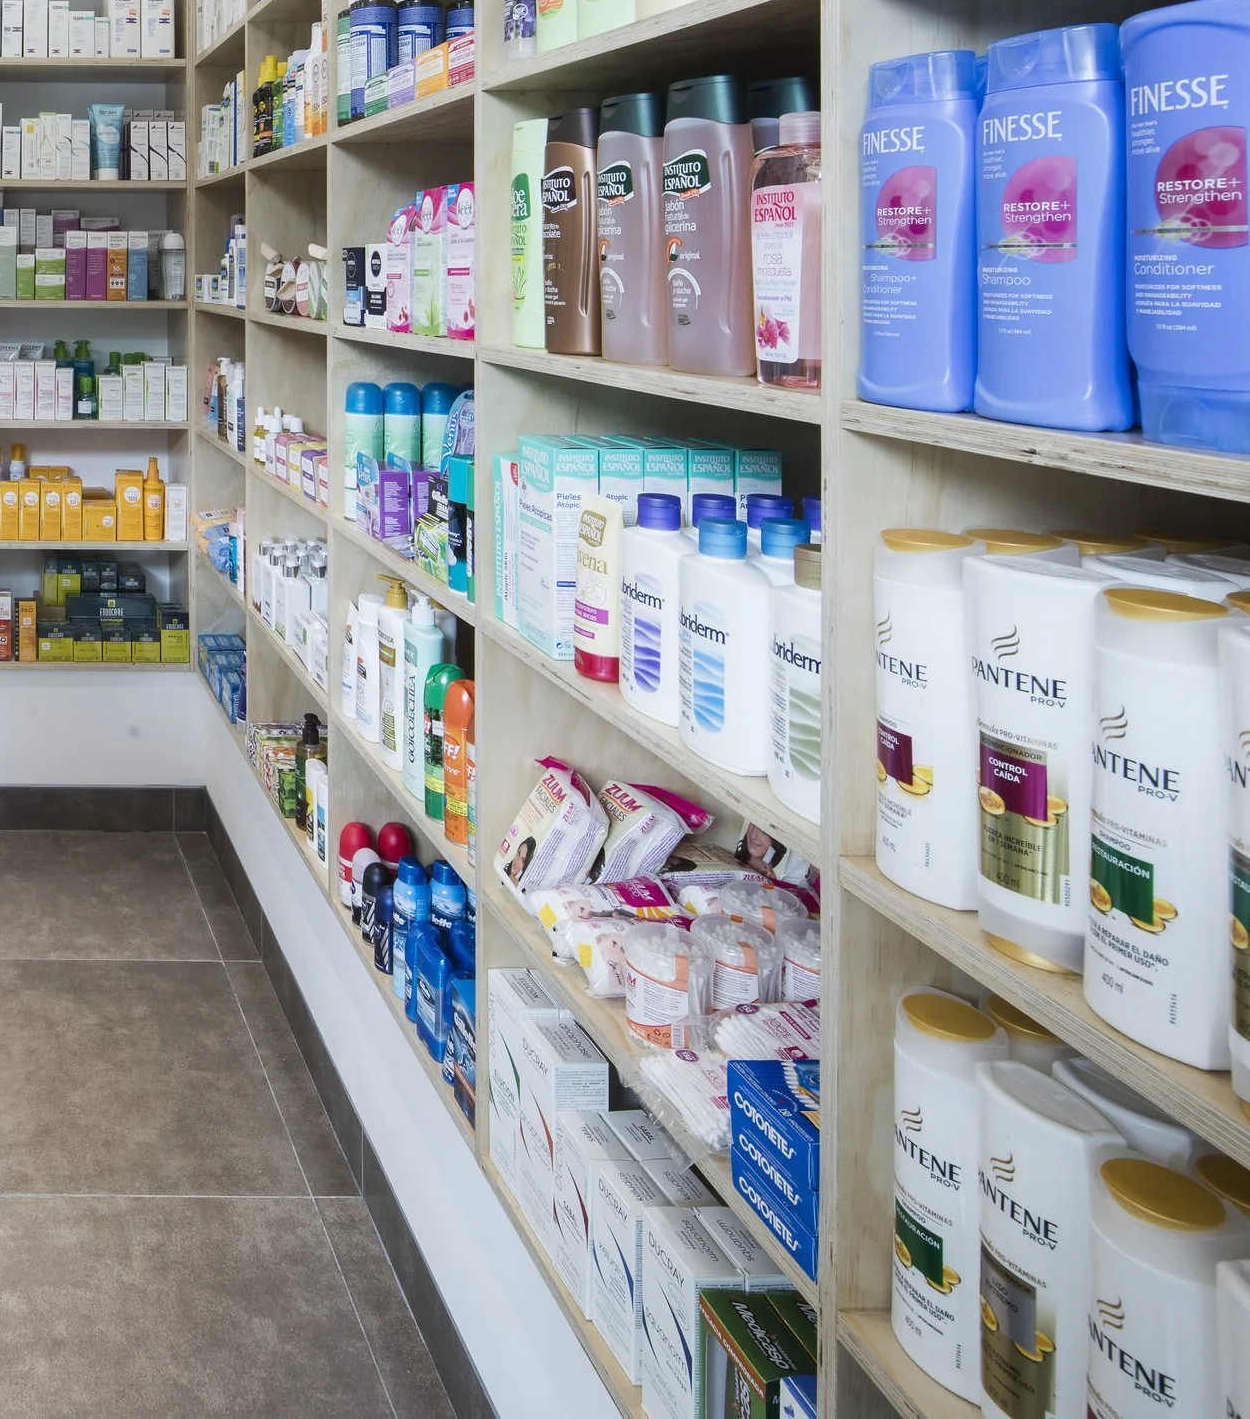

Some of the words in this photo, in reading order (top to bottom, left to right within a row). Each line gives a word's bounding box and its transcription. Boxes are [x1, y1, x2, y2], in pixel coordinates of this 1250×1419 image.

[1131, 74, 1229, 117] FINESSE
[982, 110, 1062, 146] FINESSE
[862, 126, 925, 157] FINESSE
[664, 161, 701, 177] INSTITUTO
[664, 174, 702, 192] ESPAÑOL
[1157, 177, 1242, 192] RESTORE+
[756, 191, 795, 209] INSTITUTO
[1159, 190, 1242, 205] Strengthen
[665, 200, 684, 214] jabón
[754, 205, 797, 223] ESPAÑOL
[877, 206, 932, 217] RESTORE+
[1003, 201, 1071, 213] RESTORE+
[665, 211, 684, 222] natural
[878, 215, 932, 227] Strengthen
[1005, 212, 1072, 224] Strengthen
[665, 220, 697, 235] glicerina
[763, 253, 783, 265] rosa
[1134, 262, 1214, 275] Conditioner
[982, 274, 1031, 287] Shampoo
[443, 411, 459, 458] Venus
[556, 462, 595, 473] ESPAÑOL
[558, 454, 595, 464] INSTITUTO
[602, 461, 641, 472] ESPAÑOL
[646, 462, 686, 472] ESPAÑOL
[692, 462, 732, 473] ESPAÑOL
[739, 464, 779, 474] ESPAÑOL
[556, 492, 582, 501] Pieles
[971, 654, 1067, 701] PANTENE
[1030, 695, 1066, 709] PRO-V
[988, 756, 1029, 776] CONTROL
[1092, 741, 1181, 794] ANTENE
[993, 768, 1021, 784] CAÍDA
[542, 774, 568, 803] ZUUM
[605, 783, 644, 812] ZUUM
[1138, 785, 1178, 802] PRO-V
[1004, 833, 1042, 852] INCREÍBLE
[1132, 944, 1141, 956] EL
[1142, 947, 1169, 967] DAÑO
[734, 1091, 796, 1160] COTONETES
[894, 1124, 962, 1185] ANTENE
[739, 1133, 801, 1205] COTONETES
[930, 1172, 961, 1191] PRO-V
[598, 1178, 629, 1224] DUCRAY
[978, 1171, 1059, 1244] ANTENE
[738, 1175, 799, 1251] COTONETES
[681, 1218, 720, 1263] squanorm
[718, 1219, 755, 1263] squanorm
[1022, 1228, 1057, 1251] PRO-V
[648, 1231, 686, 1286] DUCRAY
[731, 1300, 791, 1372] Medicasp
[1088, 1313, 1177, 1400] ANTENE
[1134, 1381, 1175, 1409] PRO-V
